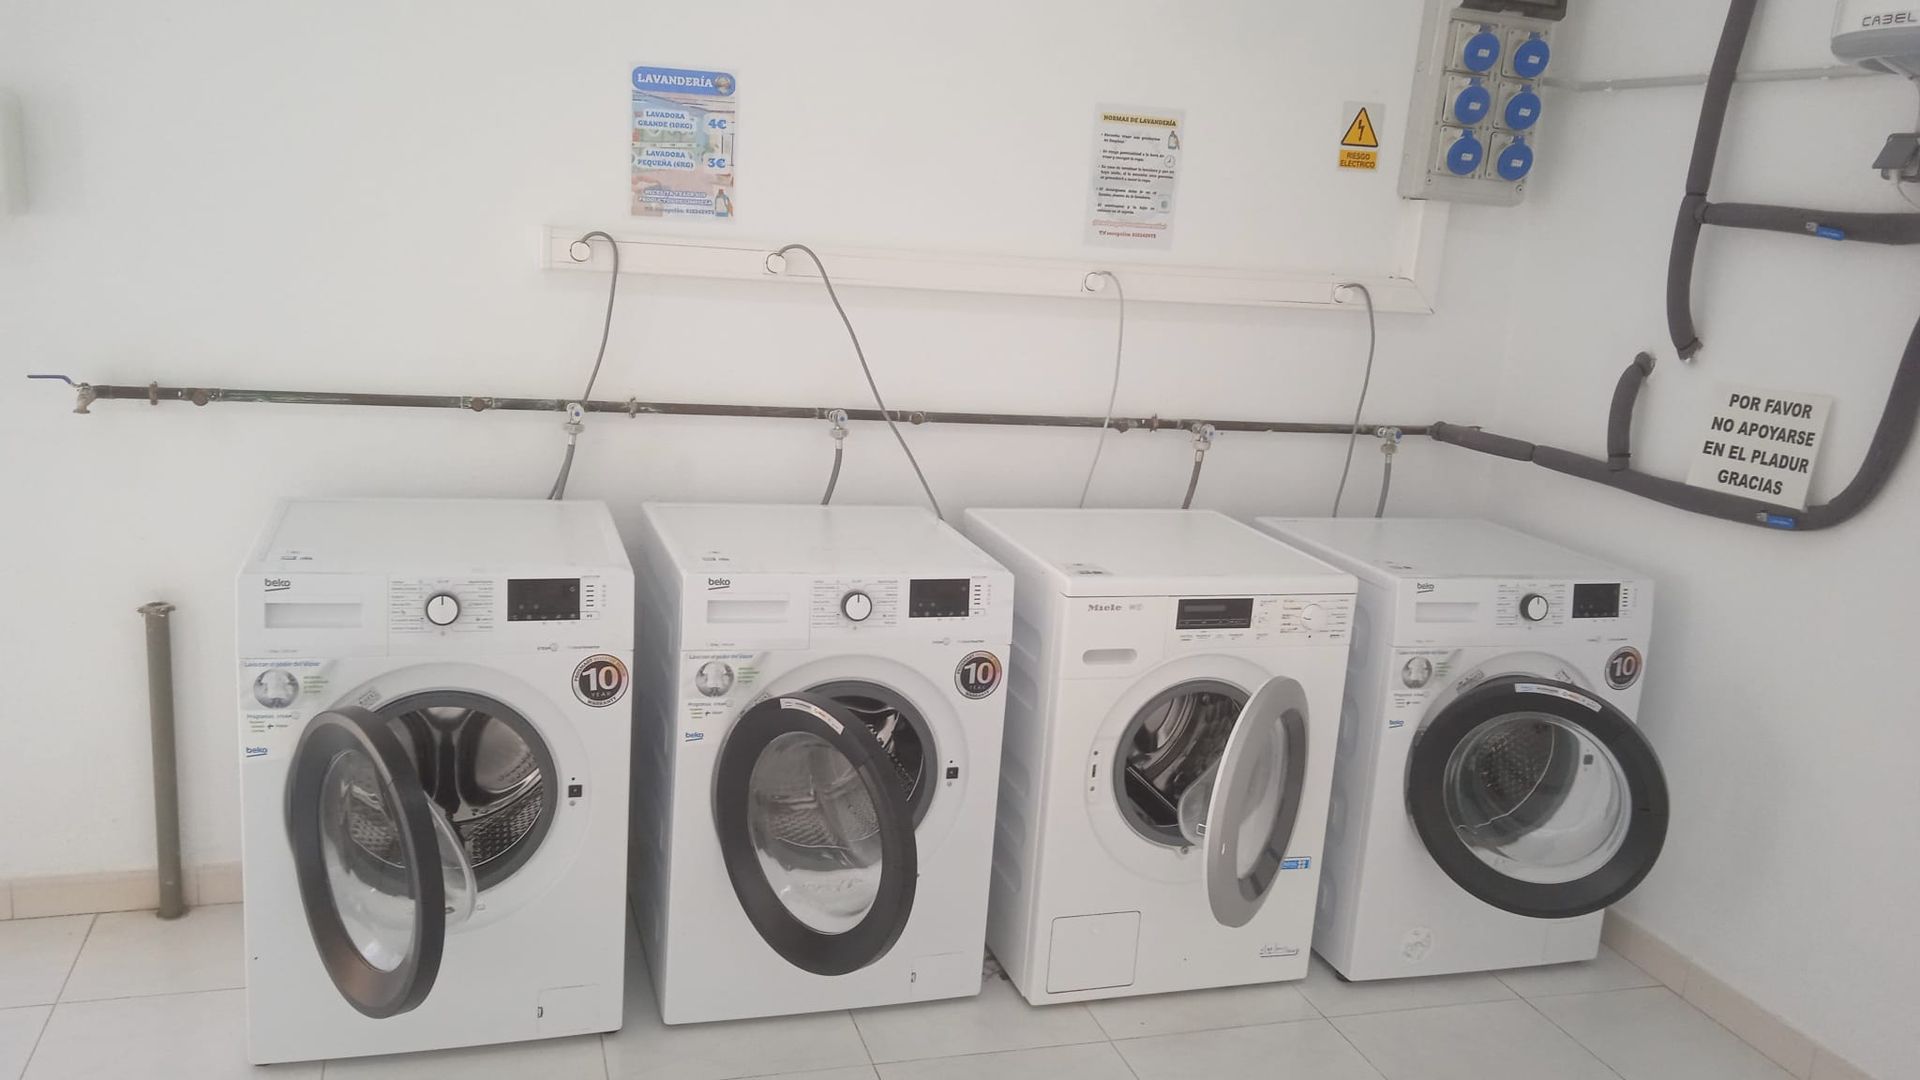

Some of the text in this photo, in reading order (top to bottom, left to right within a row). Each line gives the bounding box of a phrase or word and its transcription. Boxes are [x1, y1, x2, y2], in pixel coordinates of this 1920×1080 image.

[637, 73, 713, 88] LAVANDERÍA
[645, 110, 686, 120] LAVADORA
[1103, 114, 1177, 127] NORMAS DE LAVANDERÍA
[637, 119, 668, 128] GRANDE
[708, 118, 727, 130] 4€
[645, 150, 686, 159] LAVADORA
[1347, 151, 1371, 161] RIESGO
[707, 157, 726, 169] 3€
[1729, 393, 1813, 419] POR FAVOR
[1711, 416, 1816, 447] NO APOYARSE
[1702, 440, 1809, 474] EN EL PLADUR
[1717, 469, 1783, 495] GRACIAS
[264, 578, 291, 587] beko
[708, 577, 731, 586] beko
[963, 661, 994, 685] 10
[1612, 656, 1637, 677] 10
[581, 665, 619, 691] 10
